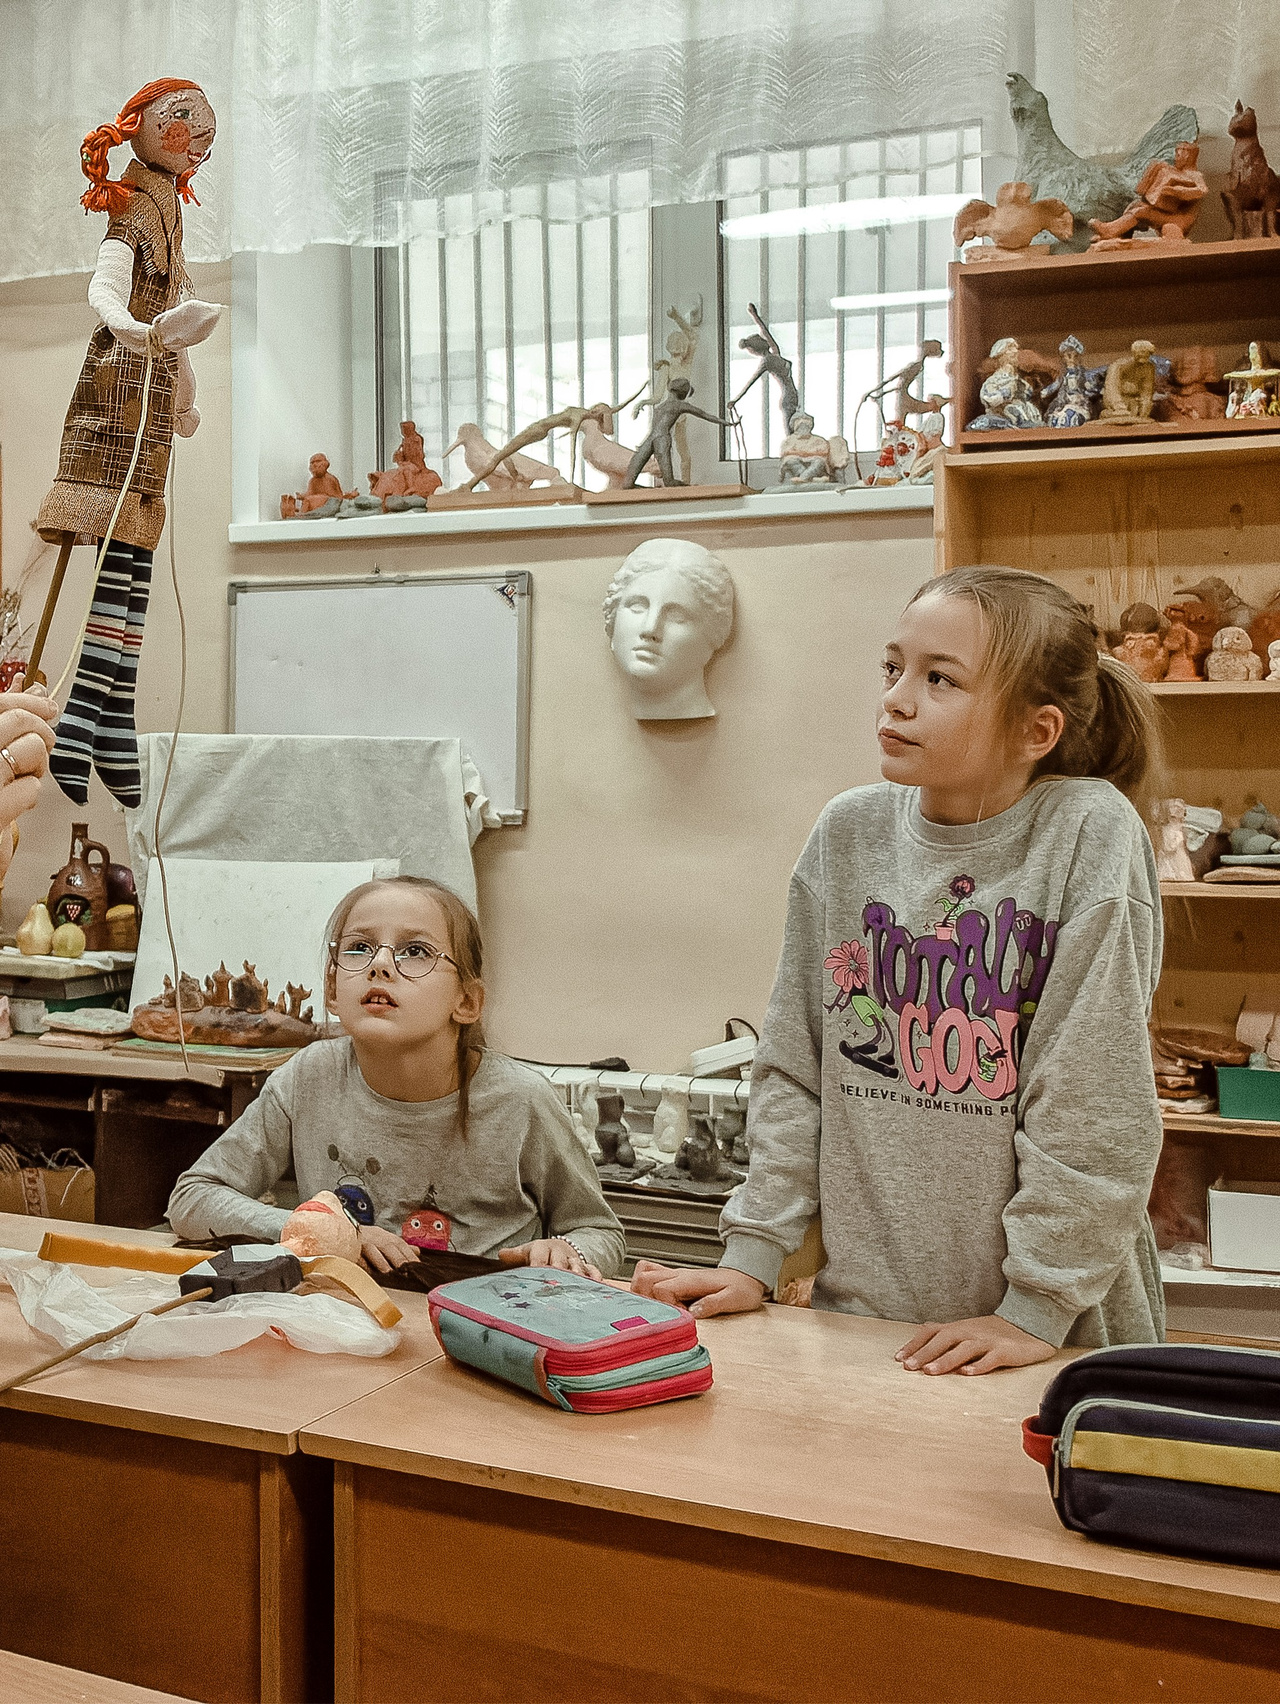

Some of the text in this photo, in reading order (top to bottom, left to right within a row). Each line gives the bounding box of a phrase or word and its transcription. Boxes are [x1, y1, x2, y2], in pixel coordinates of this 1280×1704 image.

[840, 1083, 898, 1102] BELIEVE
[901, 1093, 912, 1106] IN
[915, 1097, 994, 1117] SOMETHING
